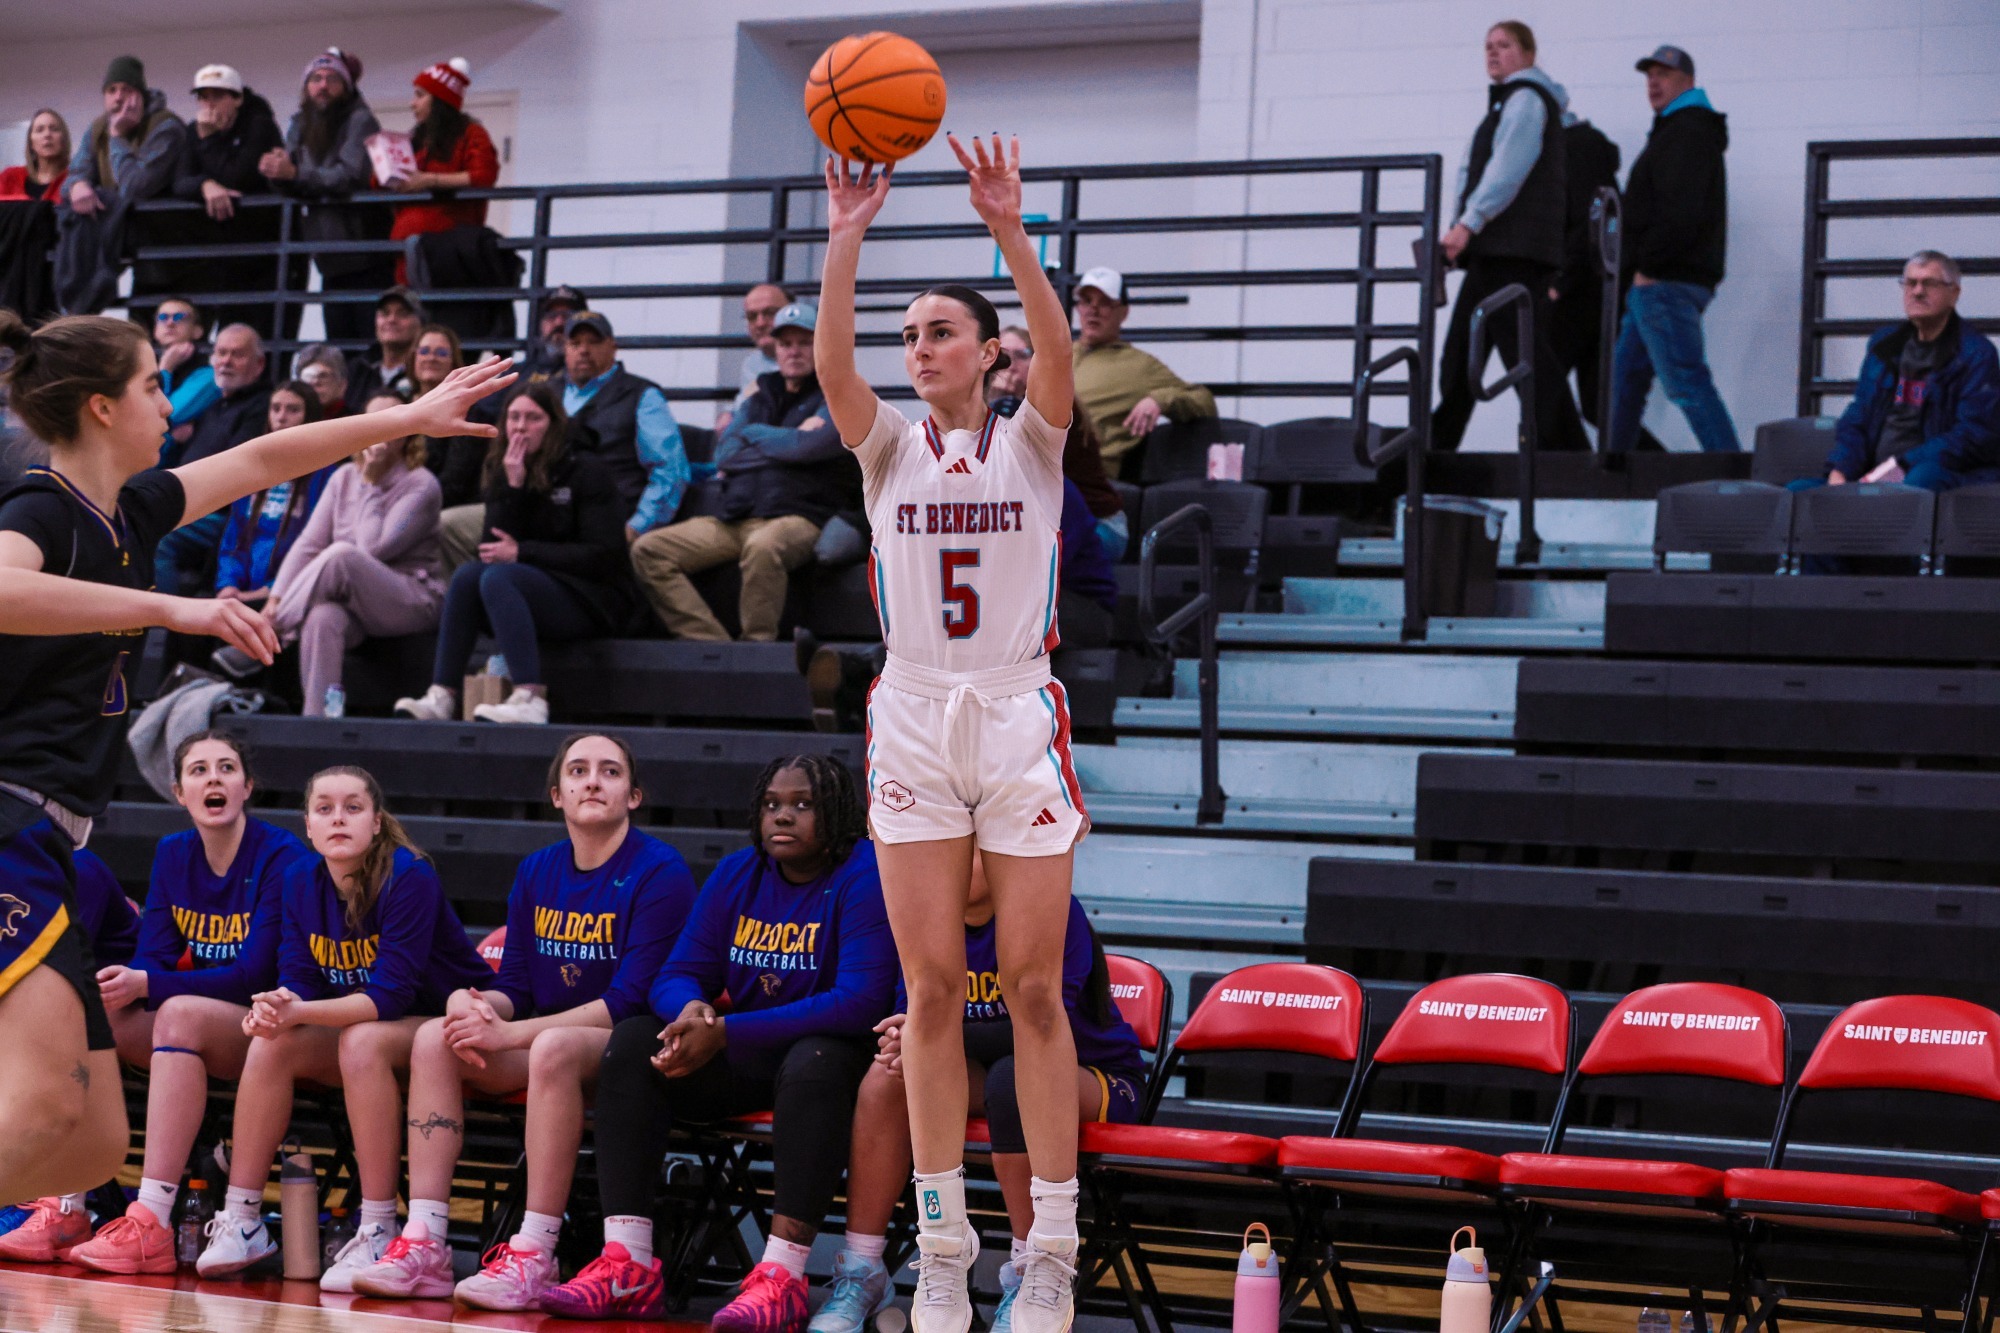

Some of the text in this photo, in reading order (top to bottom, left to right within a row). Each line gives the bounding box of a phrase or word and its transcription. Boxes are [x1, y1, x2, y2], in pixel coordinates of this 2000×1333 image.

[897, 501, 1024, 534] ST. BENEDICT
[939, 548, 981, 640] 5
[534, 905, 616, 943] WILDCAT
[733, 914, 821, 954] WILDCAT
[482, 945, 504, 960] SAI
[729, 946, 817, 970] BASKETBALL
[1109, 984, 1144, 999] EDICT
[1220, 988, 1343, 1010] SAINT BENEDICT
[1419, 1000, 1547, 1022] SAINT BENEDICT
[1622, 1010, 1761, 1031] SAINT BENEDICT
[1844, 1024, 1988, 1046] SAINT BENEDICT
